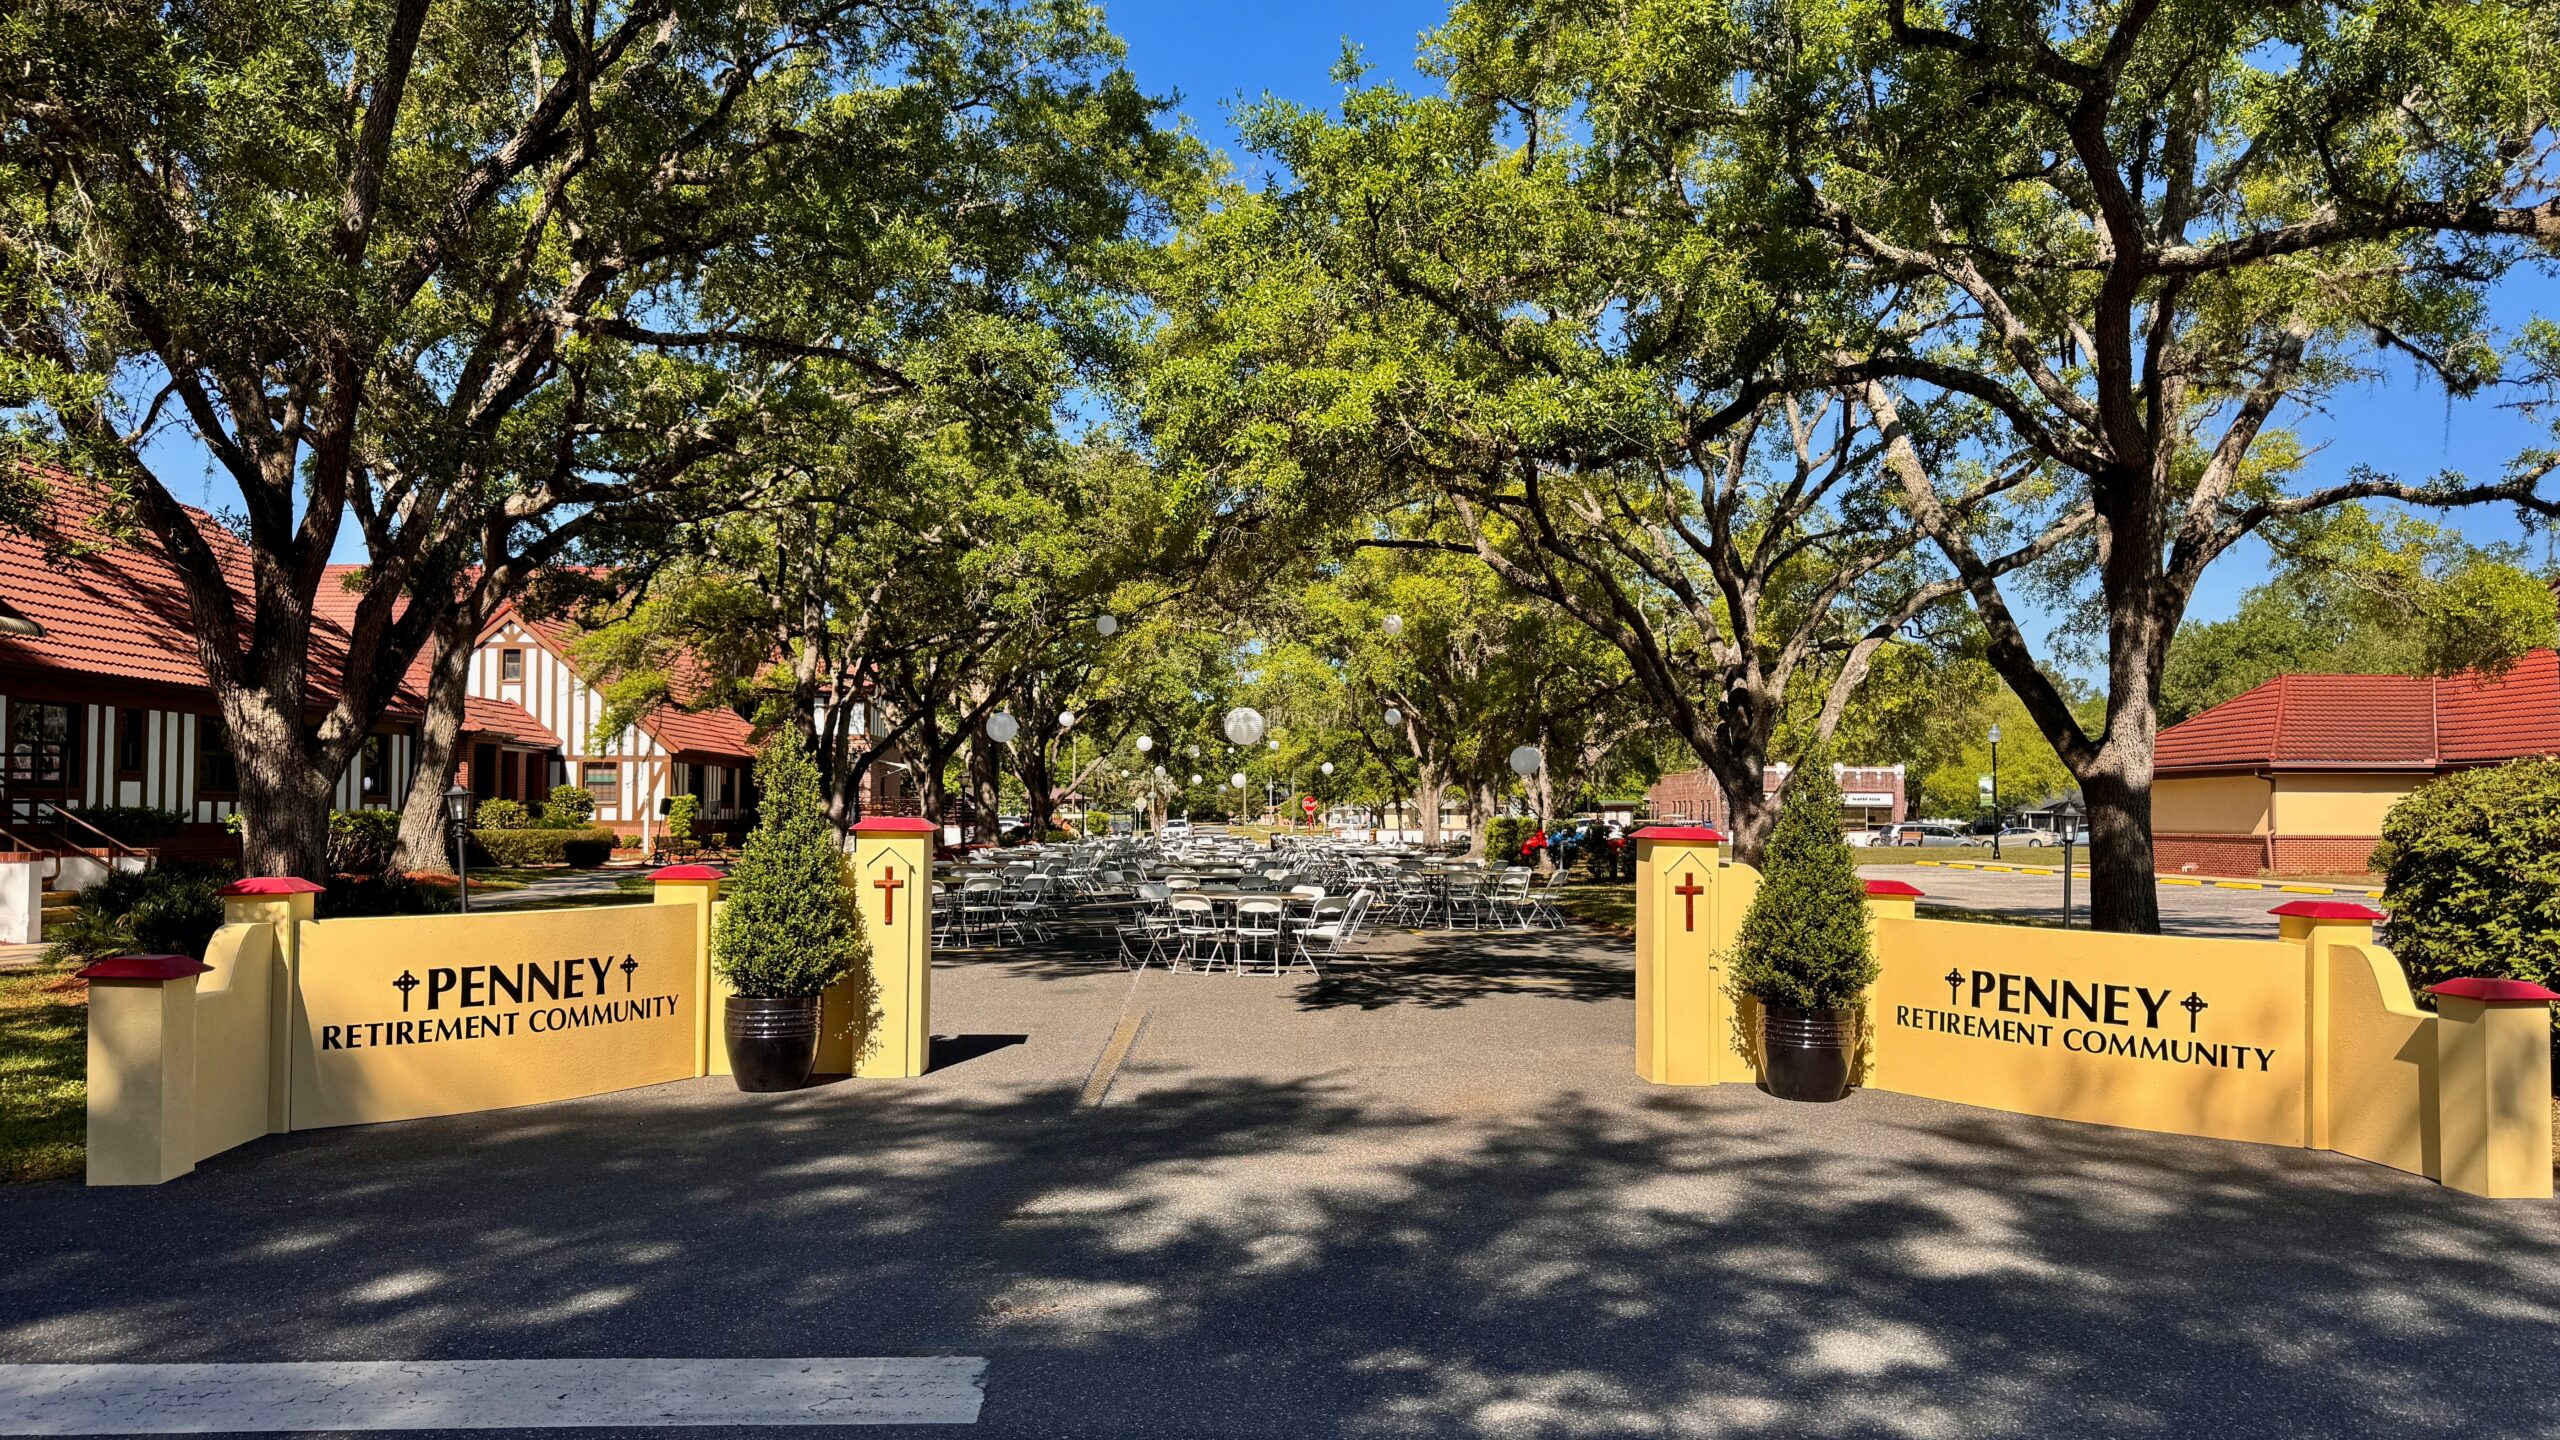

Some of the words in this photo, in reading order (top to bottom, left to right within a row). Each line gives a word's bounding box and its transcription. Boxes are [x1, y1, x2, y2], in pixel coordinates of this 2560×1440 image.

[427, 956, 615, 1010] PENNEY
[1971, 970, 2173, 1029] PENNEY
[321, 1012, 520, 1051] RETIREMENT
[528, 994, 680, 1033] COMMUNITY
[1896, 1005, 2054, 1047] RETIREMENT
[2063, 1028, 2277, 1072] COMMUNITY
